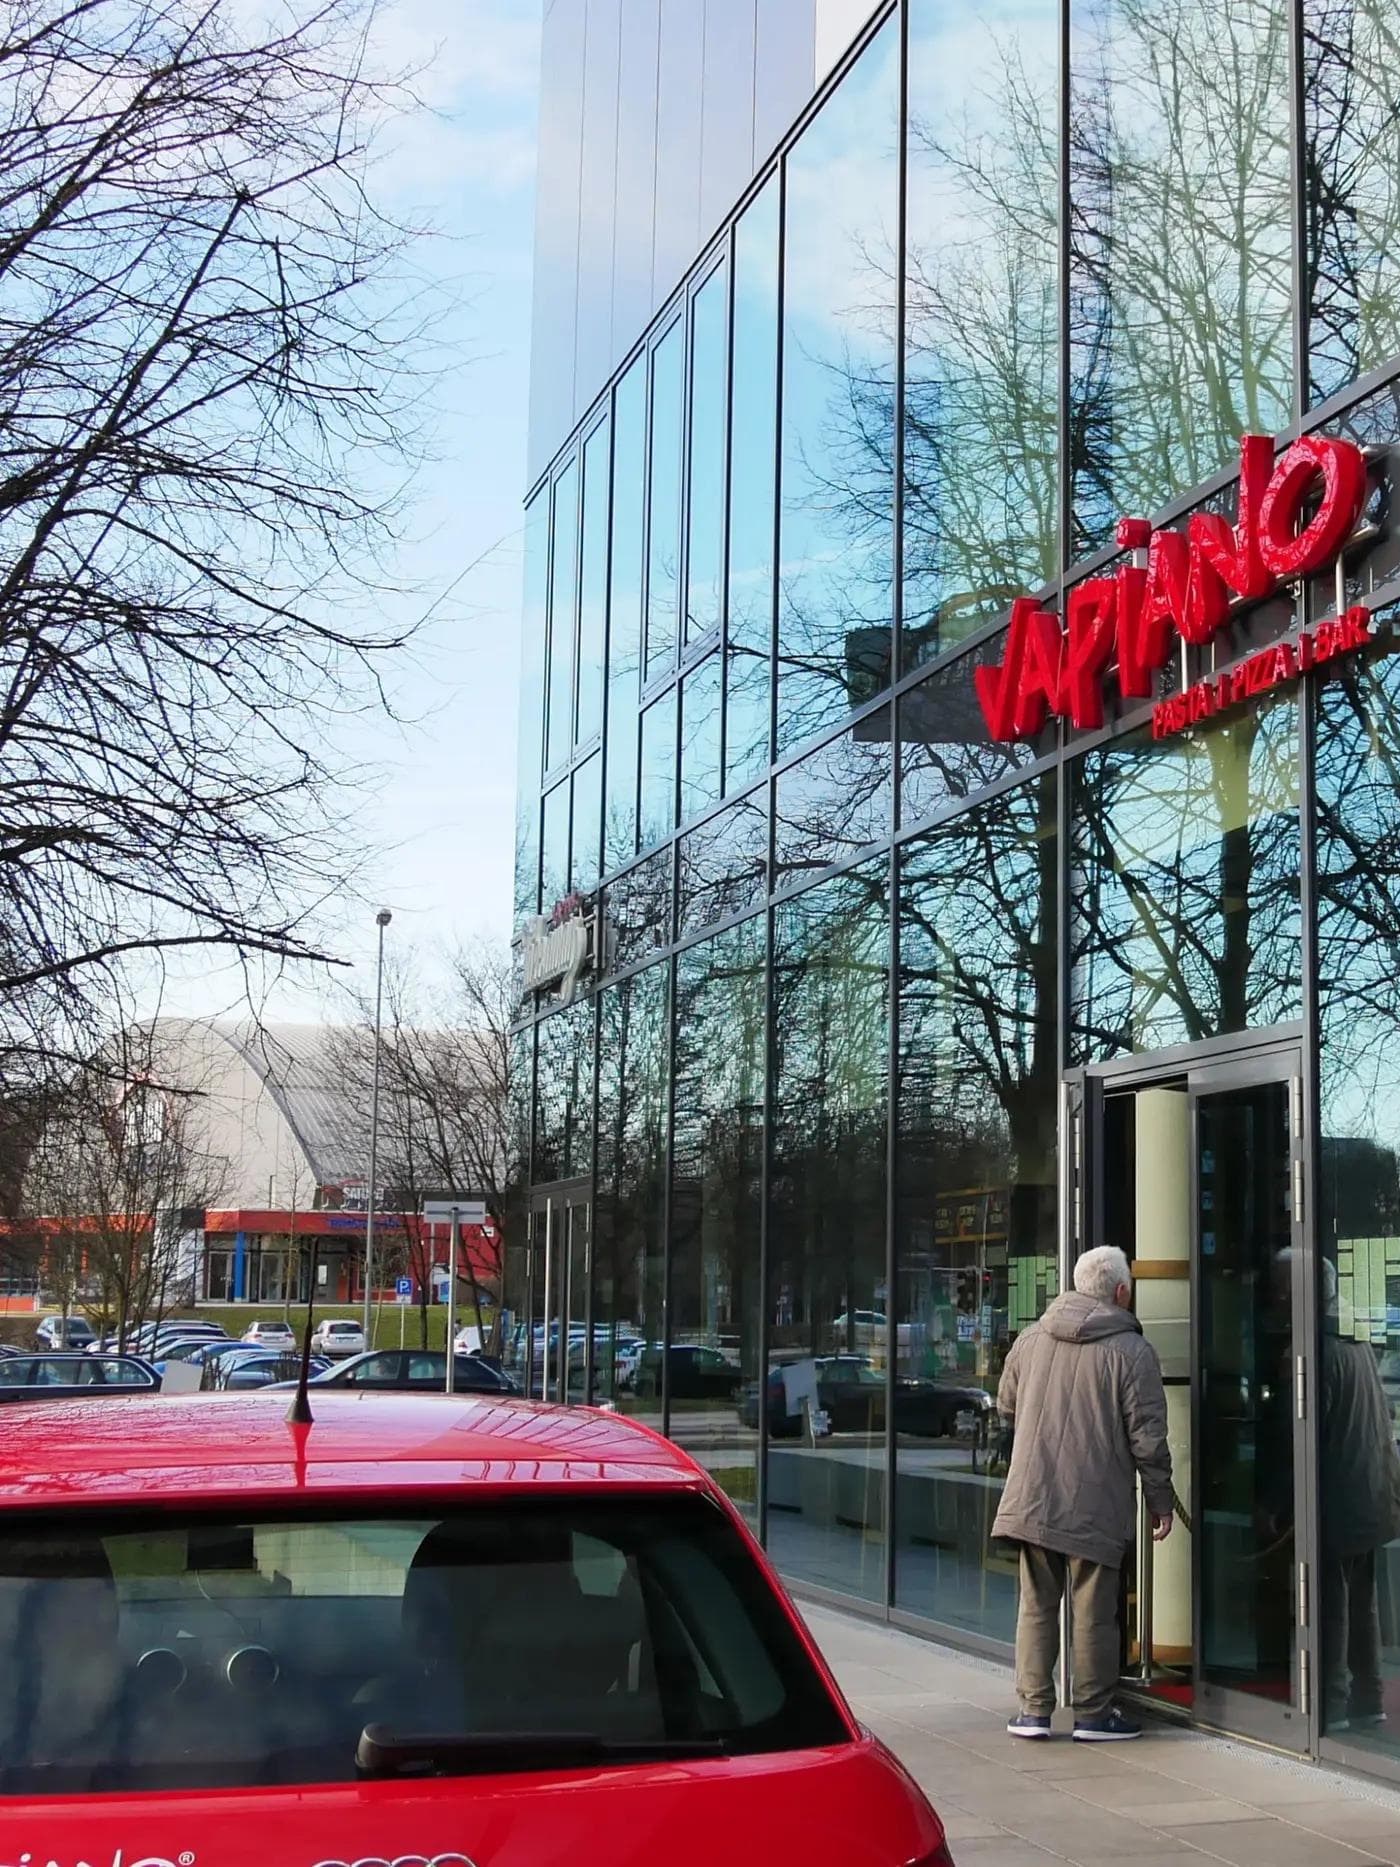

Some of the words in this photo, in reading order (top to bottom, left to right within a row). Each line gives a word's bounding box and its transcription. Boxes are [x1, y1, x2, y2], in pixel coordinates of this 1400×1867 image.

[1152, 682, 1216, 740] PASTA
[1232, 643, 1297, 701] PIZZA
[1315, 606, 1372, 663] BAR
